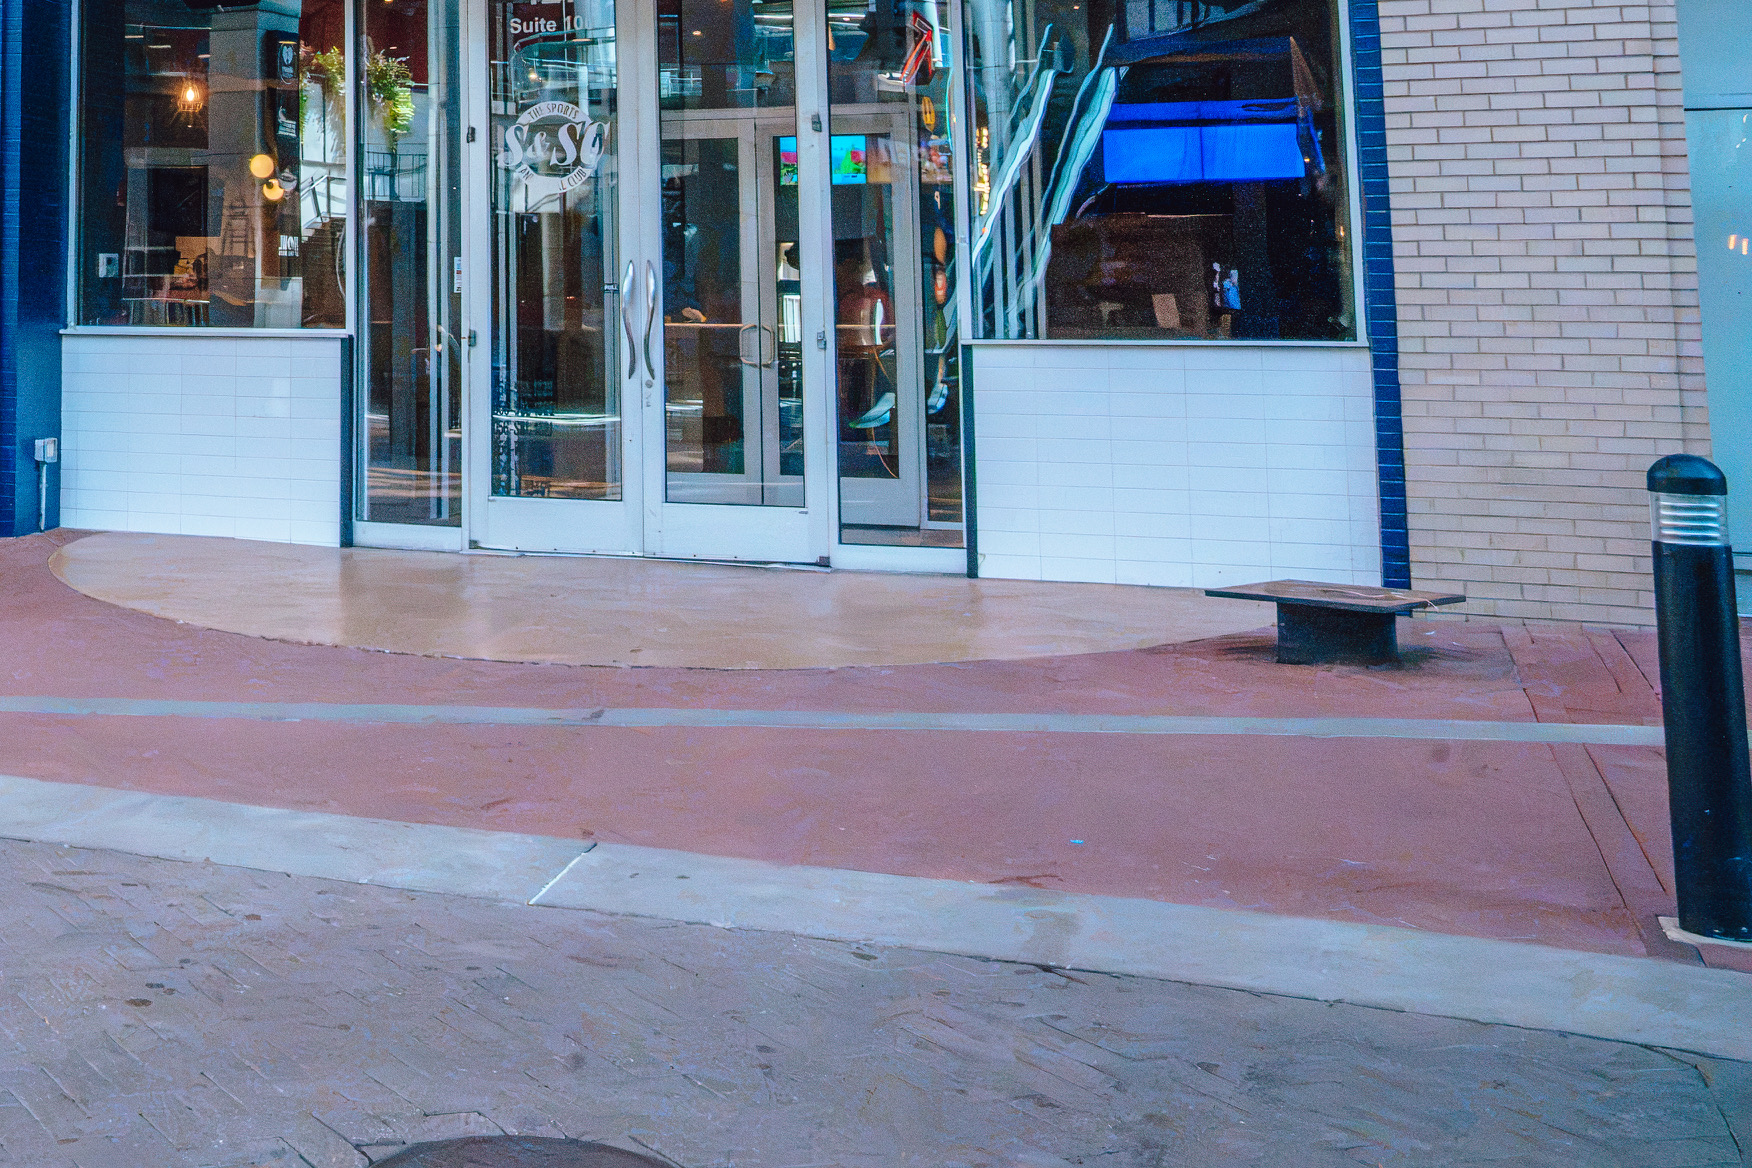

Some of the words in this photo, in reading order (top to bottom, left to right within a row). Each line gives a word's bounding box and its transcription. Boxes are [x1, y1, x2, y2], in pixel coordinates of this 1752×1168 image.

[509, 16, 557, 34] Suite
[546, 103, 580, 120] SPORTS
[567, 168, 587, 187] CLUB
